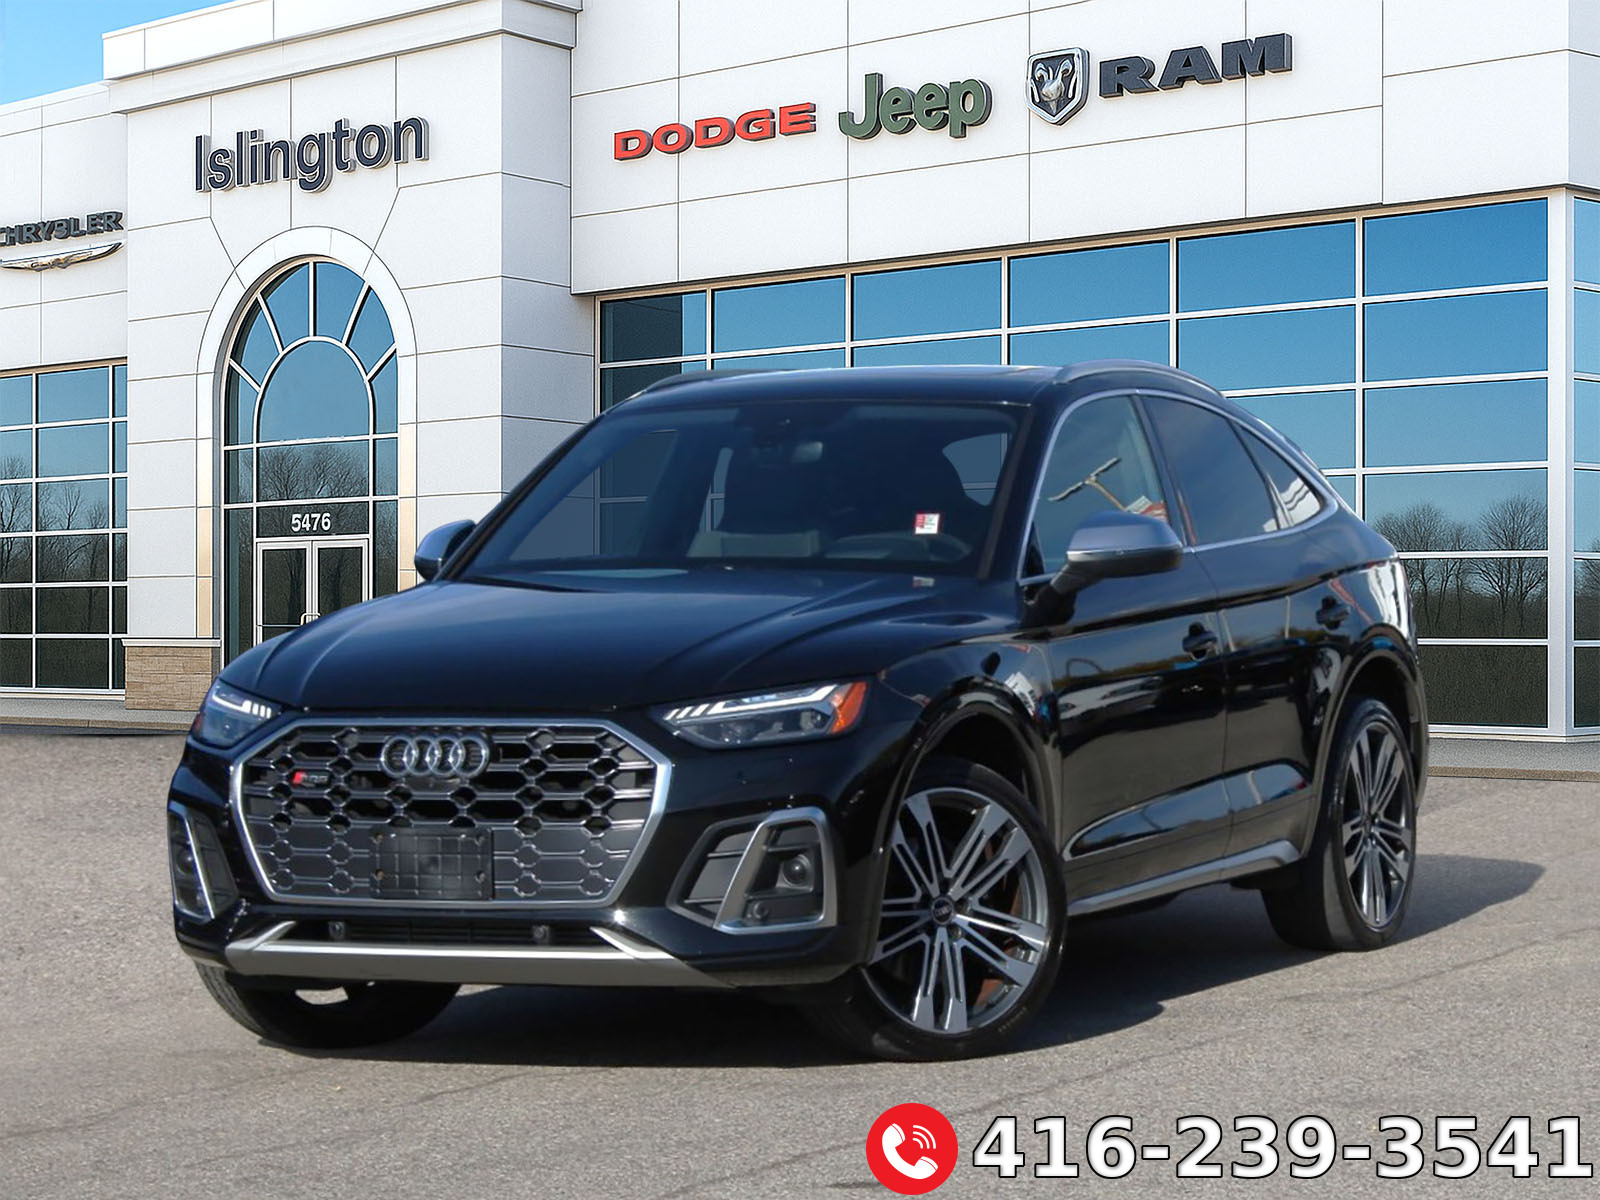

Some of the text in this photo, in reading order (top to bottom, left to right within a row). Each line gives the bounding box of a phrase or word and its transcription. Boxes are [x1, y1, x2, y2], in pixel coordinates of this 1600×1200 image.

[614, 32, 1293, 161] DODGE Jeep RAM
[194, 115, 430, 193] Islington
[291, 512, 331, 532] 5476
